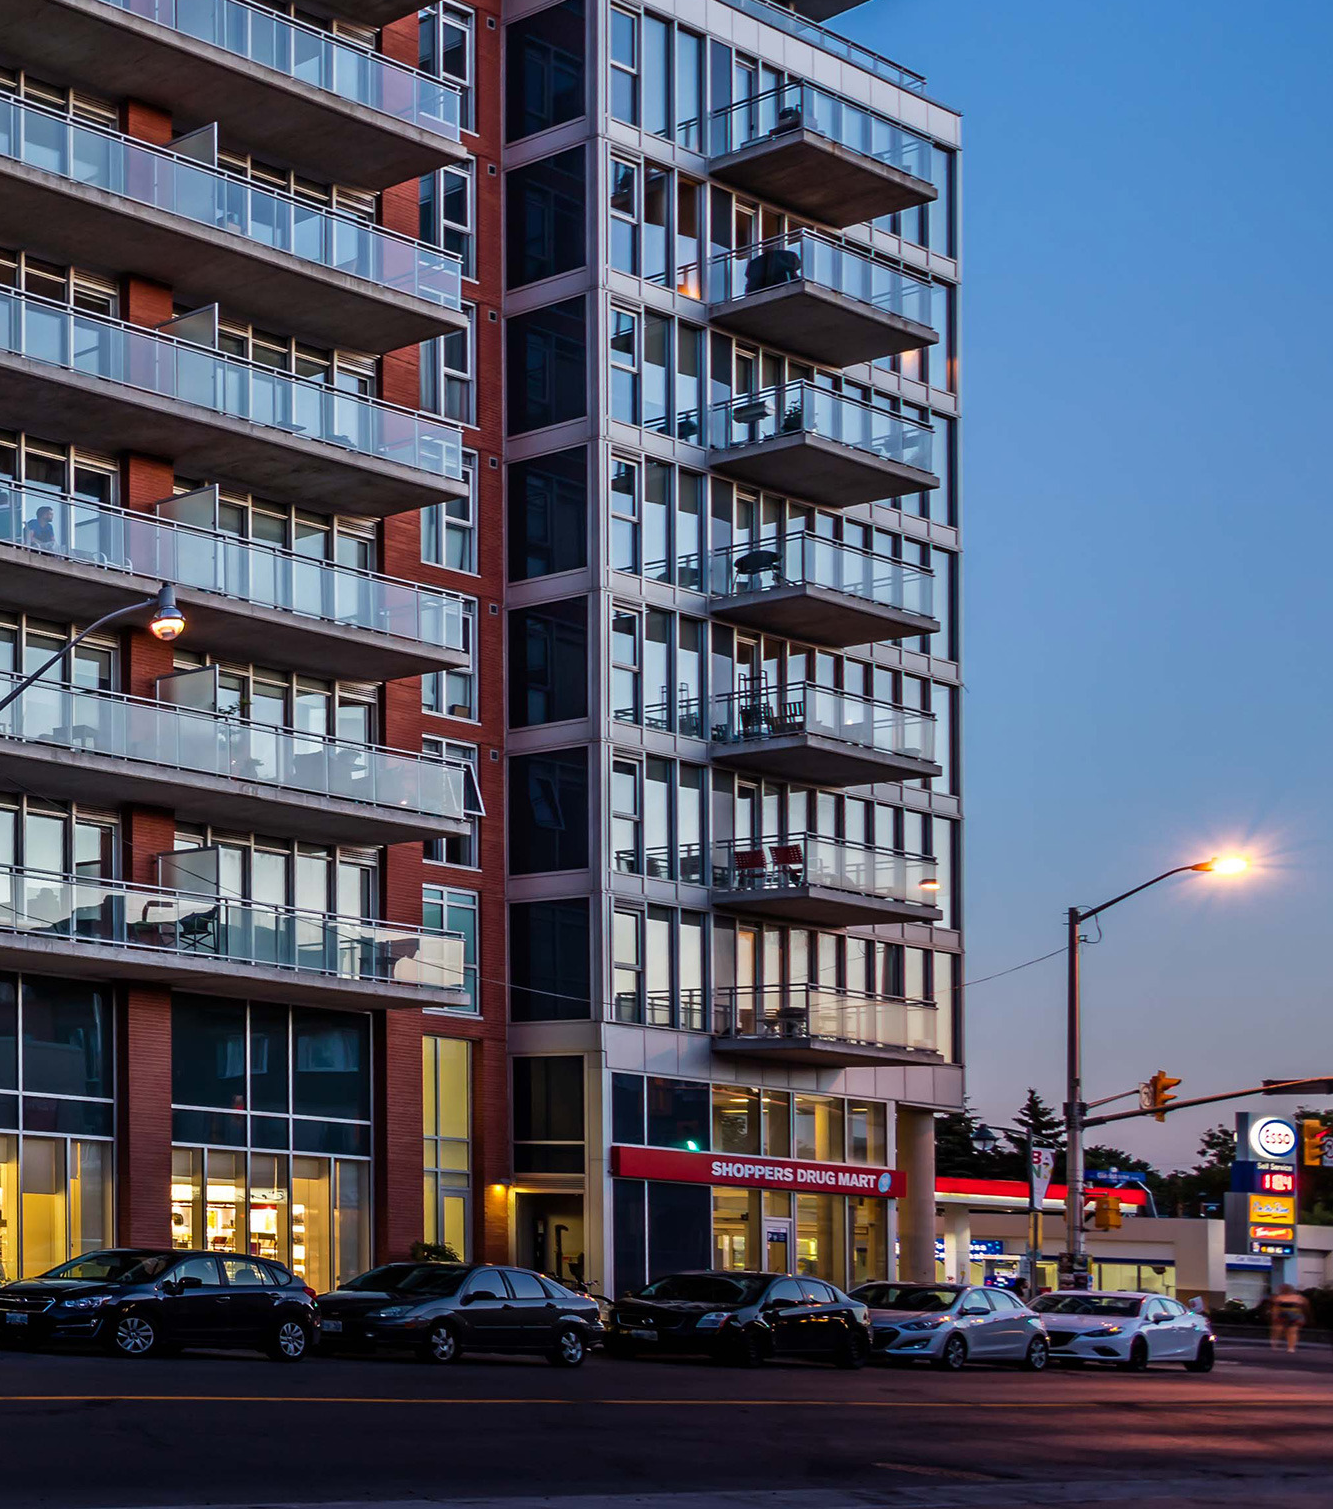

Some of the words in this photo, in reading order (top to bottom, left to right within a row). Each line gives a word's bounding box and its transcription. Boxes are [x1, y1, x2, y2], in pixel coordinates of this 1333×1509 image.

[1265, 1129, 1291, 1144] Esso
[711, 1161, 794, 1182] SHOPPERS
[797, 1168, 836, 1185] DRUG
[838, 1172, 877, 1188] MART
